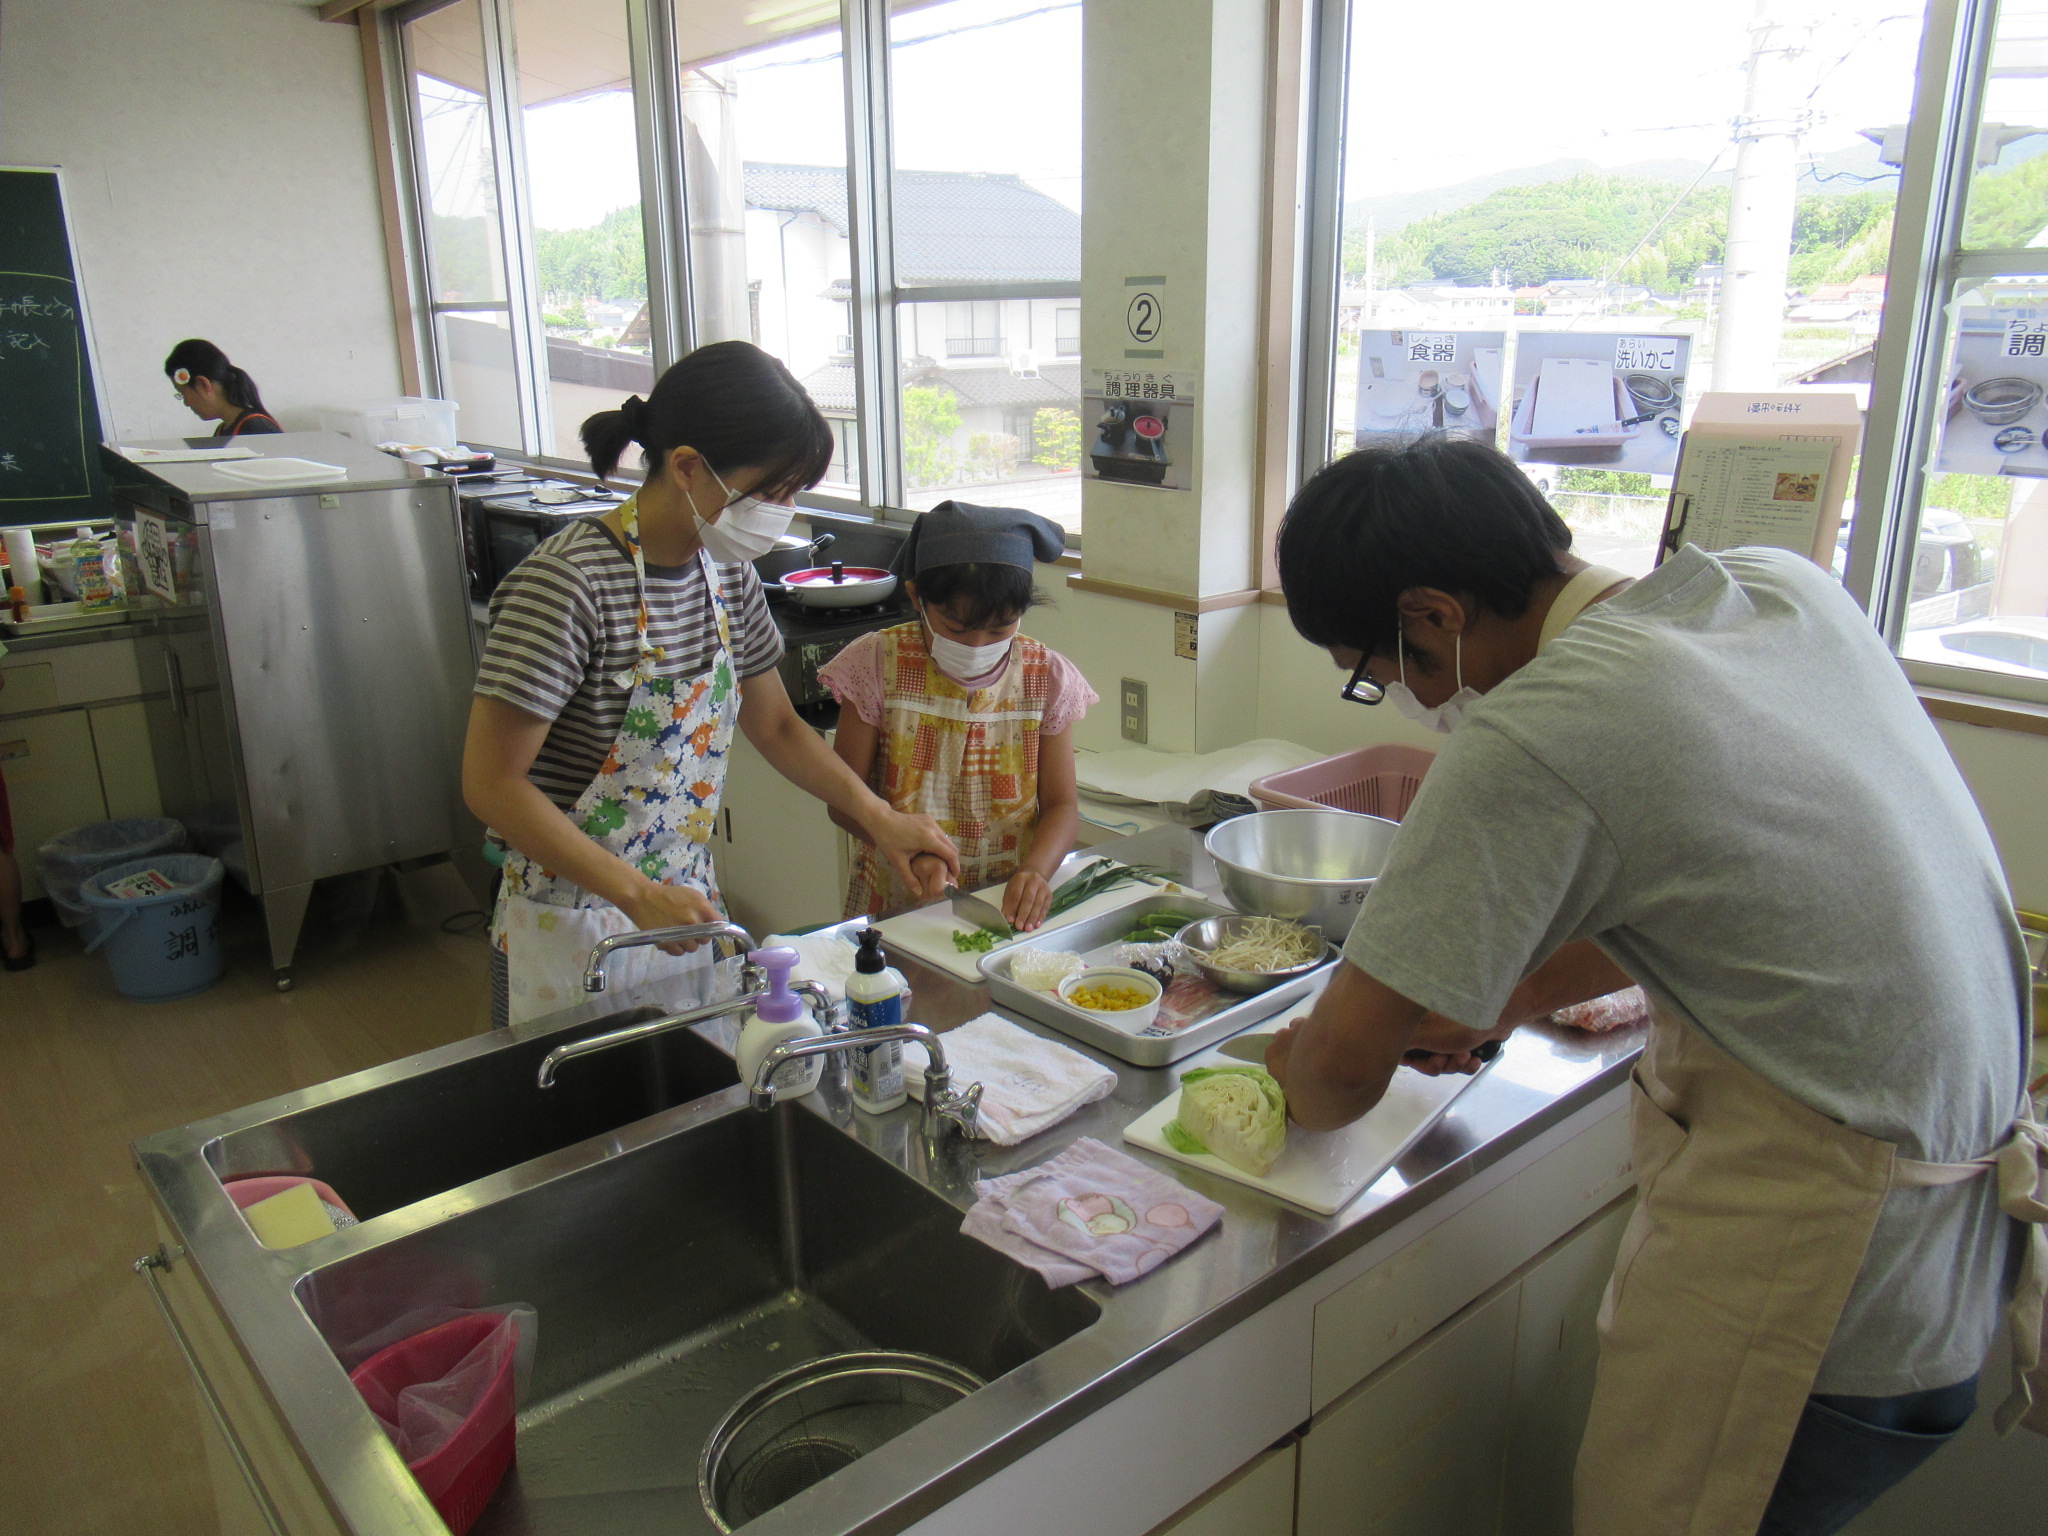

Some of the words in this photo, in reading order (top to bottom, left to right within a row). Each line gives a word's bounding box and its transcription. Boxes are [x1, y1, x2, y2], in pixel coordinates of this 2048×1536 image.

[1410, 333, 1456, 343] しょっき
[1618, 338, 1645, 348] あらい
[2008, 334, 2046, 356] 調
[1409, 344, 1456, 362] 食器
[1616, 349, 1675, 370] 洗いかご
[1105, 382, 1176, 400] 調理器具
